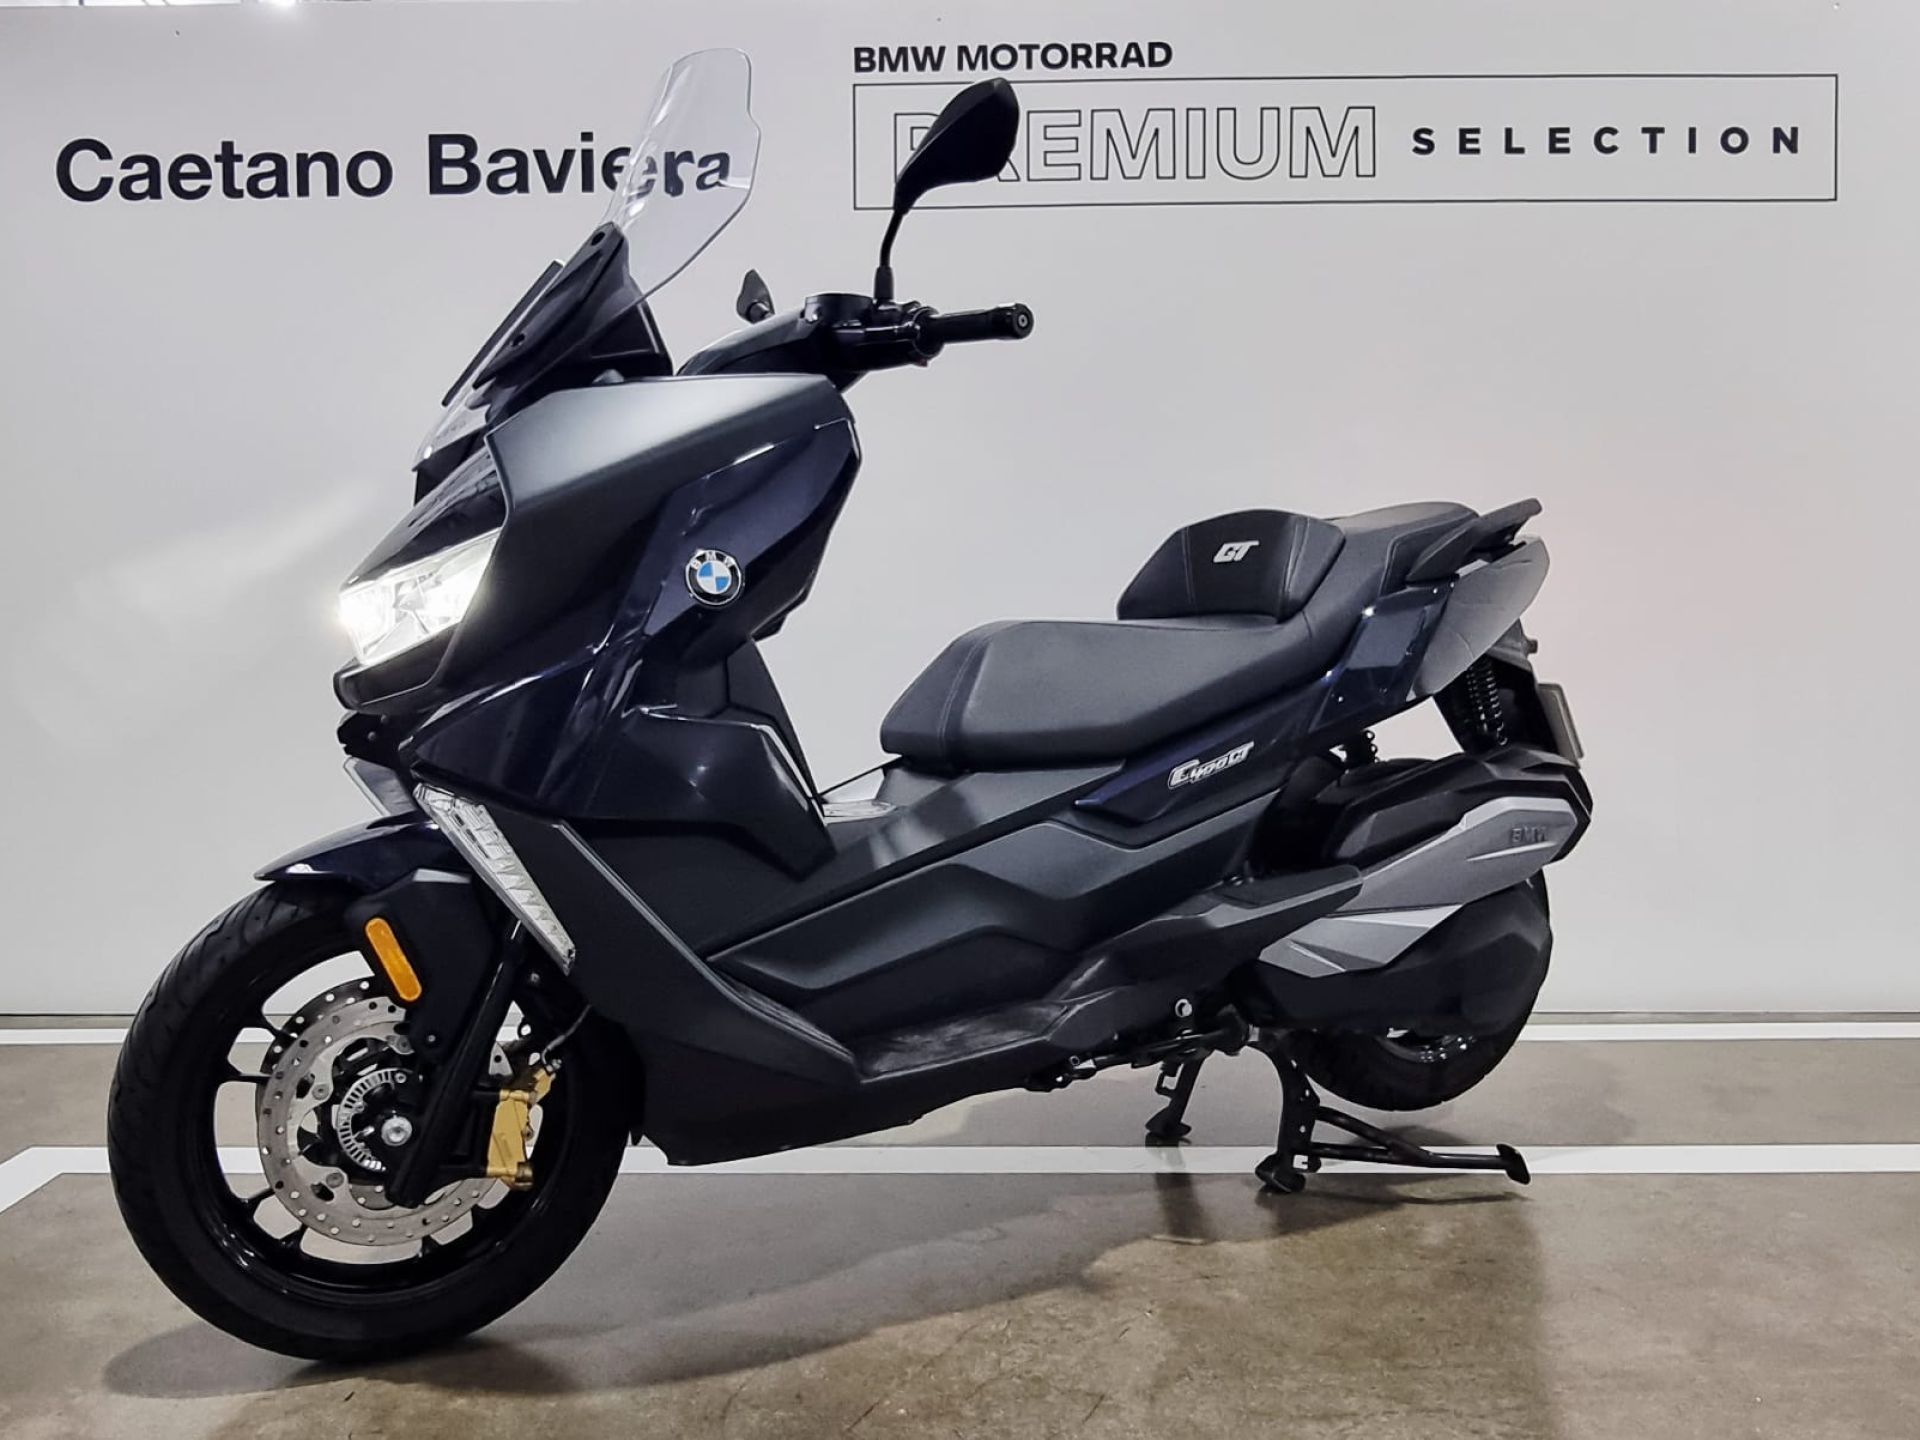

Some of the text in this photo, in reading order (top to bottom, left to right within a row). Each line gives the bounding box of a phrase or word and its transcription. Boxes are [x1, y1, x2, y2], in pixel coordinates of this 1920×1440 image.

[854, 42, 1172, 72] BMW MOTORRAD
[894, 106, 1798, 182] PEMIUM SELECTION
[57, 132, 731, 202] Caetano Baviera
[690, 550, 736, 570] BMW
[1213, 540, 1259, 563] GT
